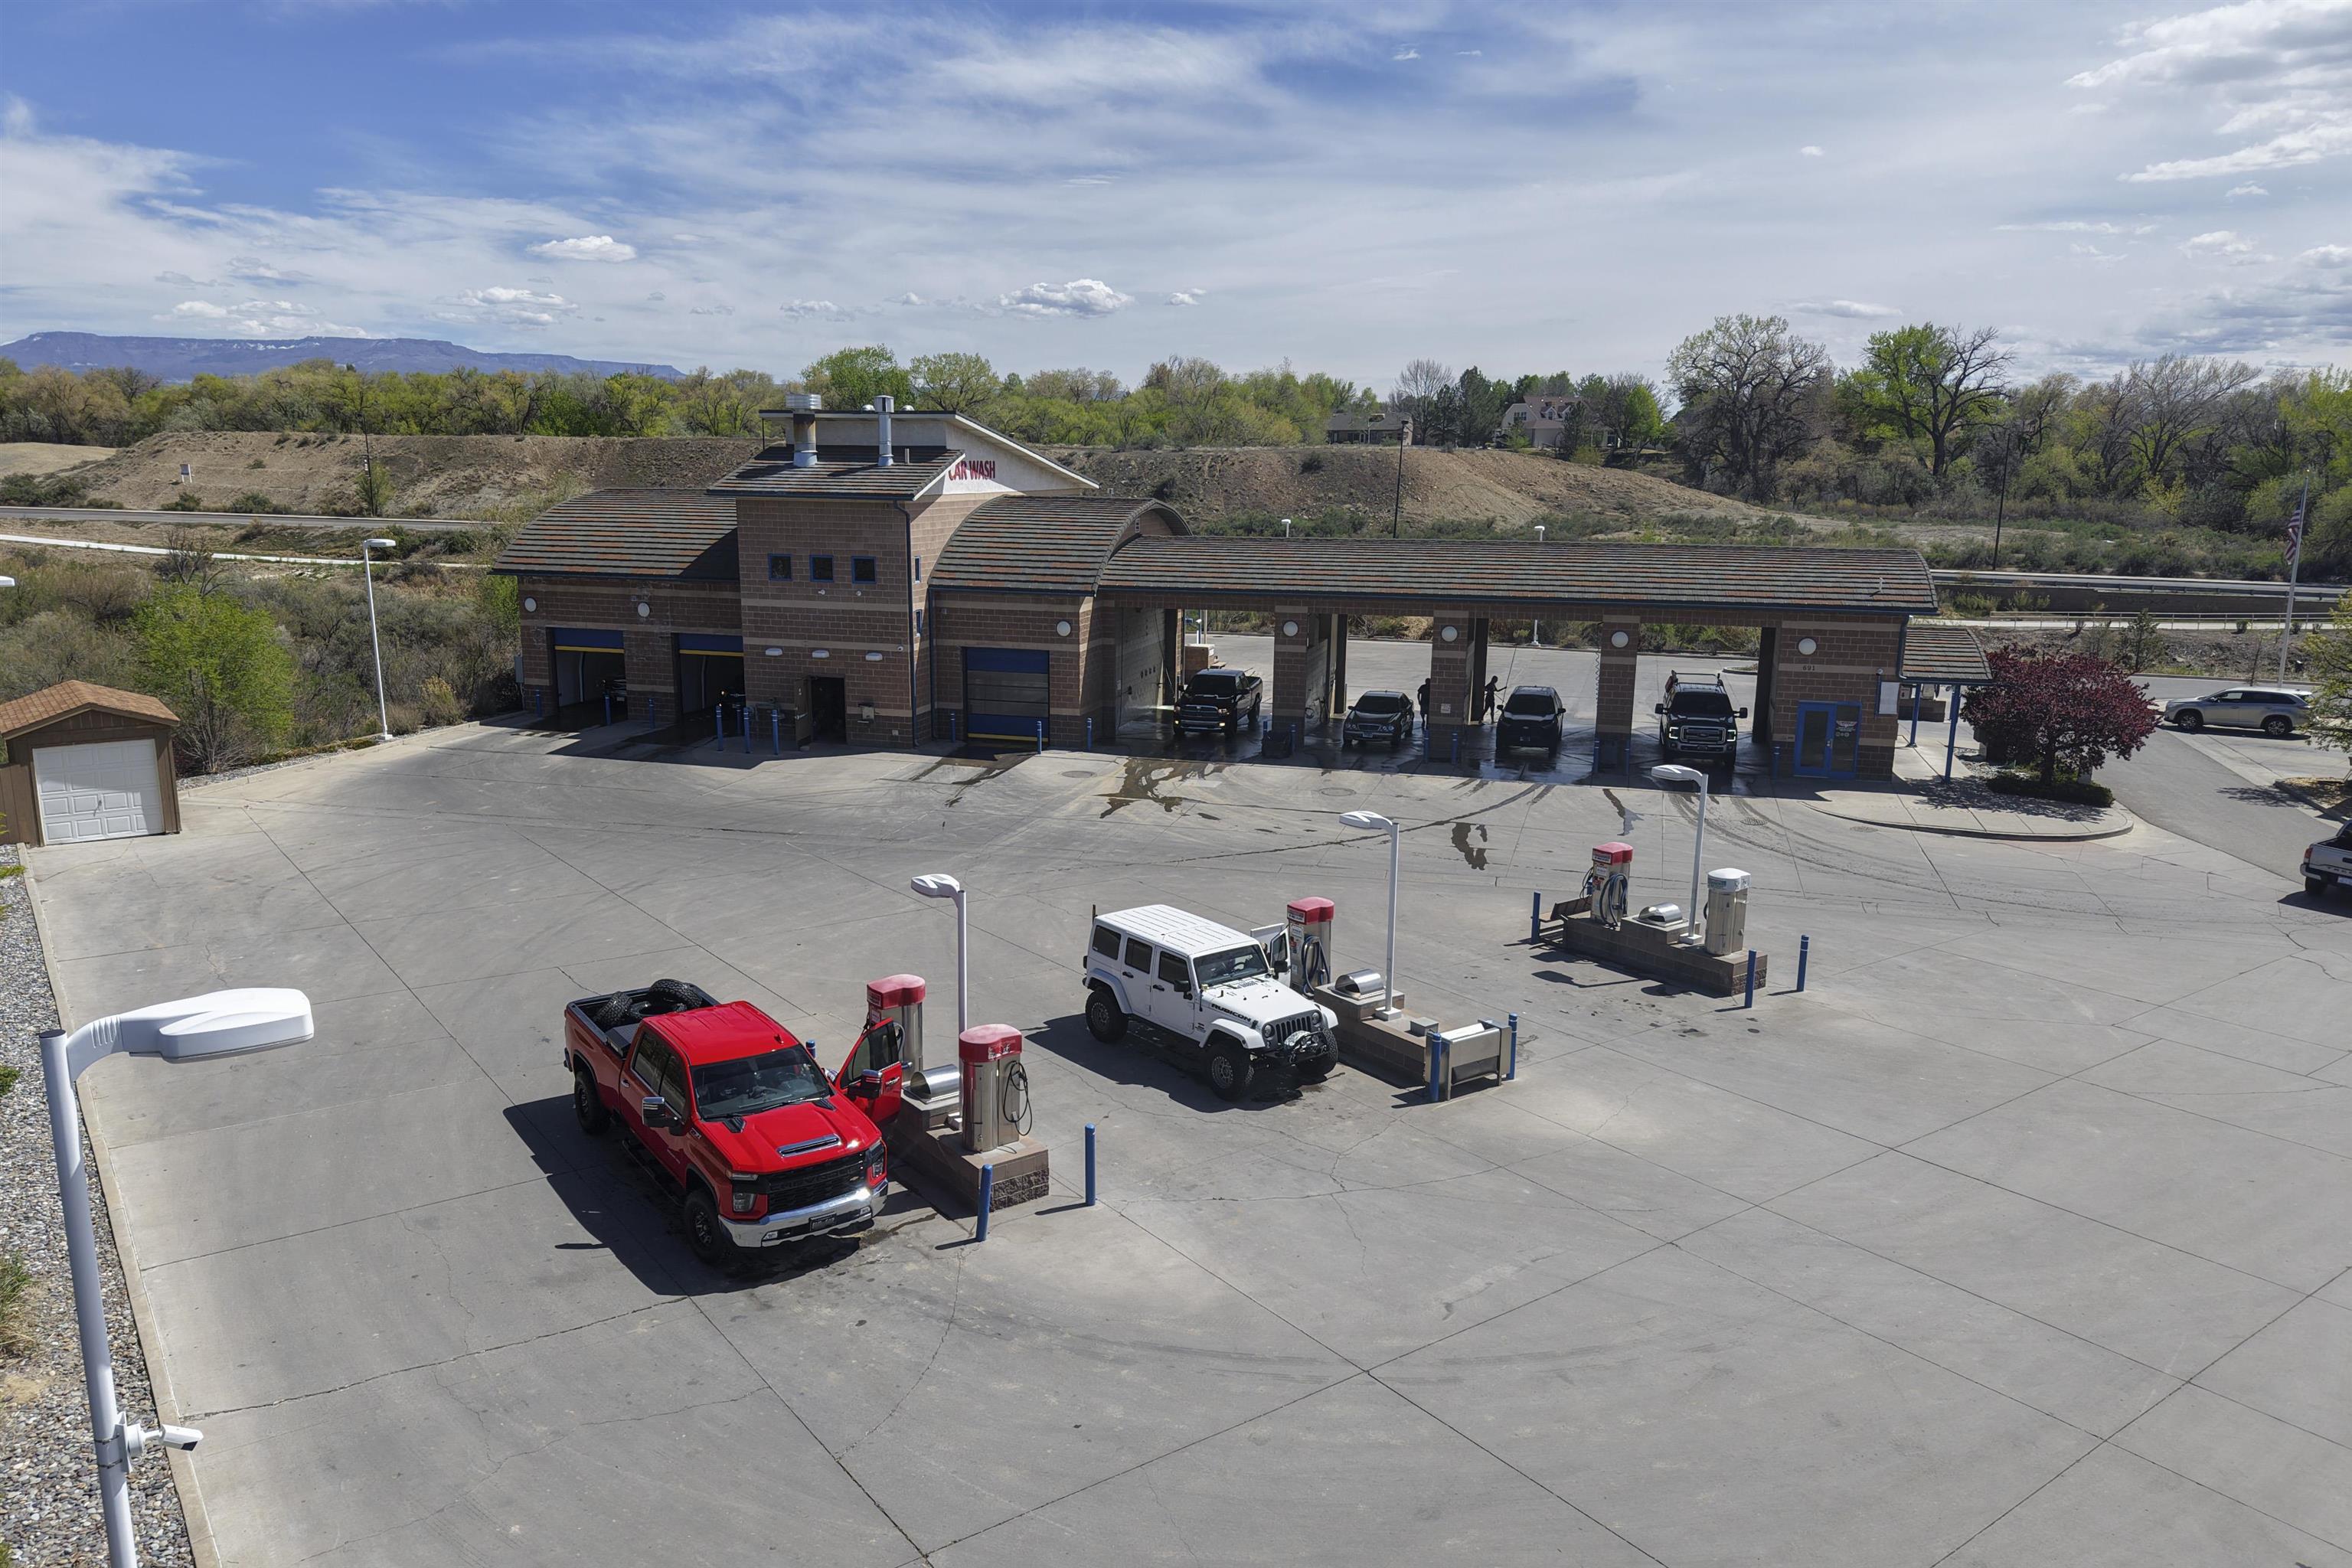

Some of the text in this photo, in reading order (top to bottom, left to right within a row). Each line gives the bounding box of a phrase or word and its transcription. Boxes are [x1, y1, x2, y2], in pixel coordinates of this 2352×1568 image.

[949, 460, 996, 481] CAR WASH
[1211, 1003, 1252, 1022] RUBICON
